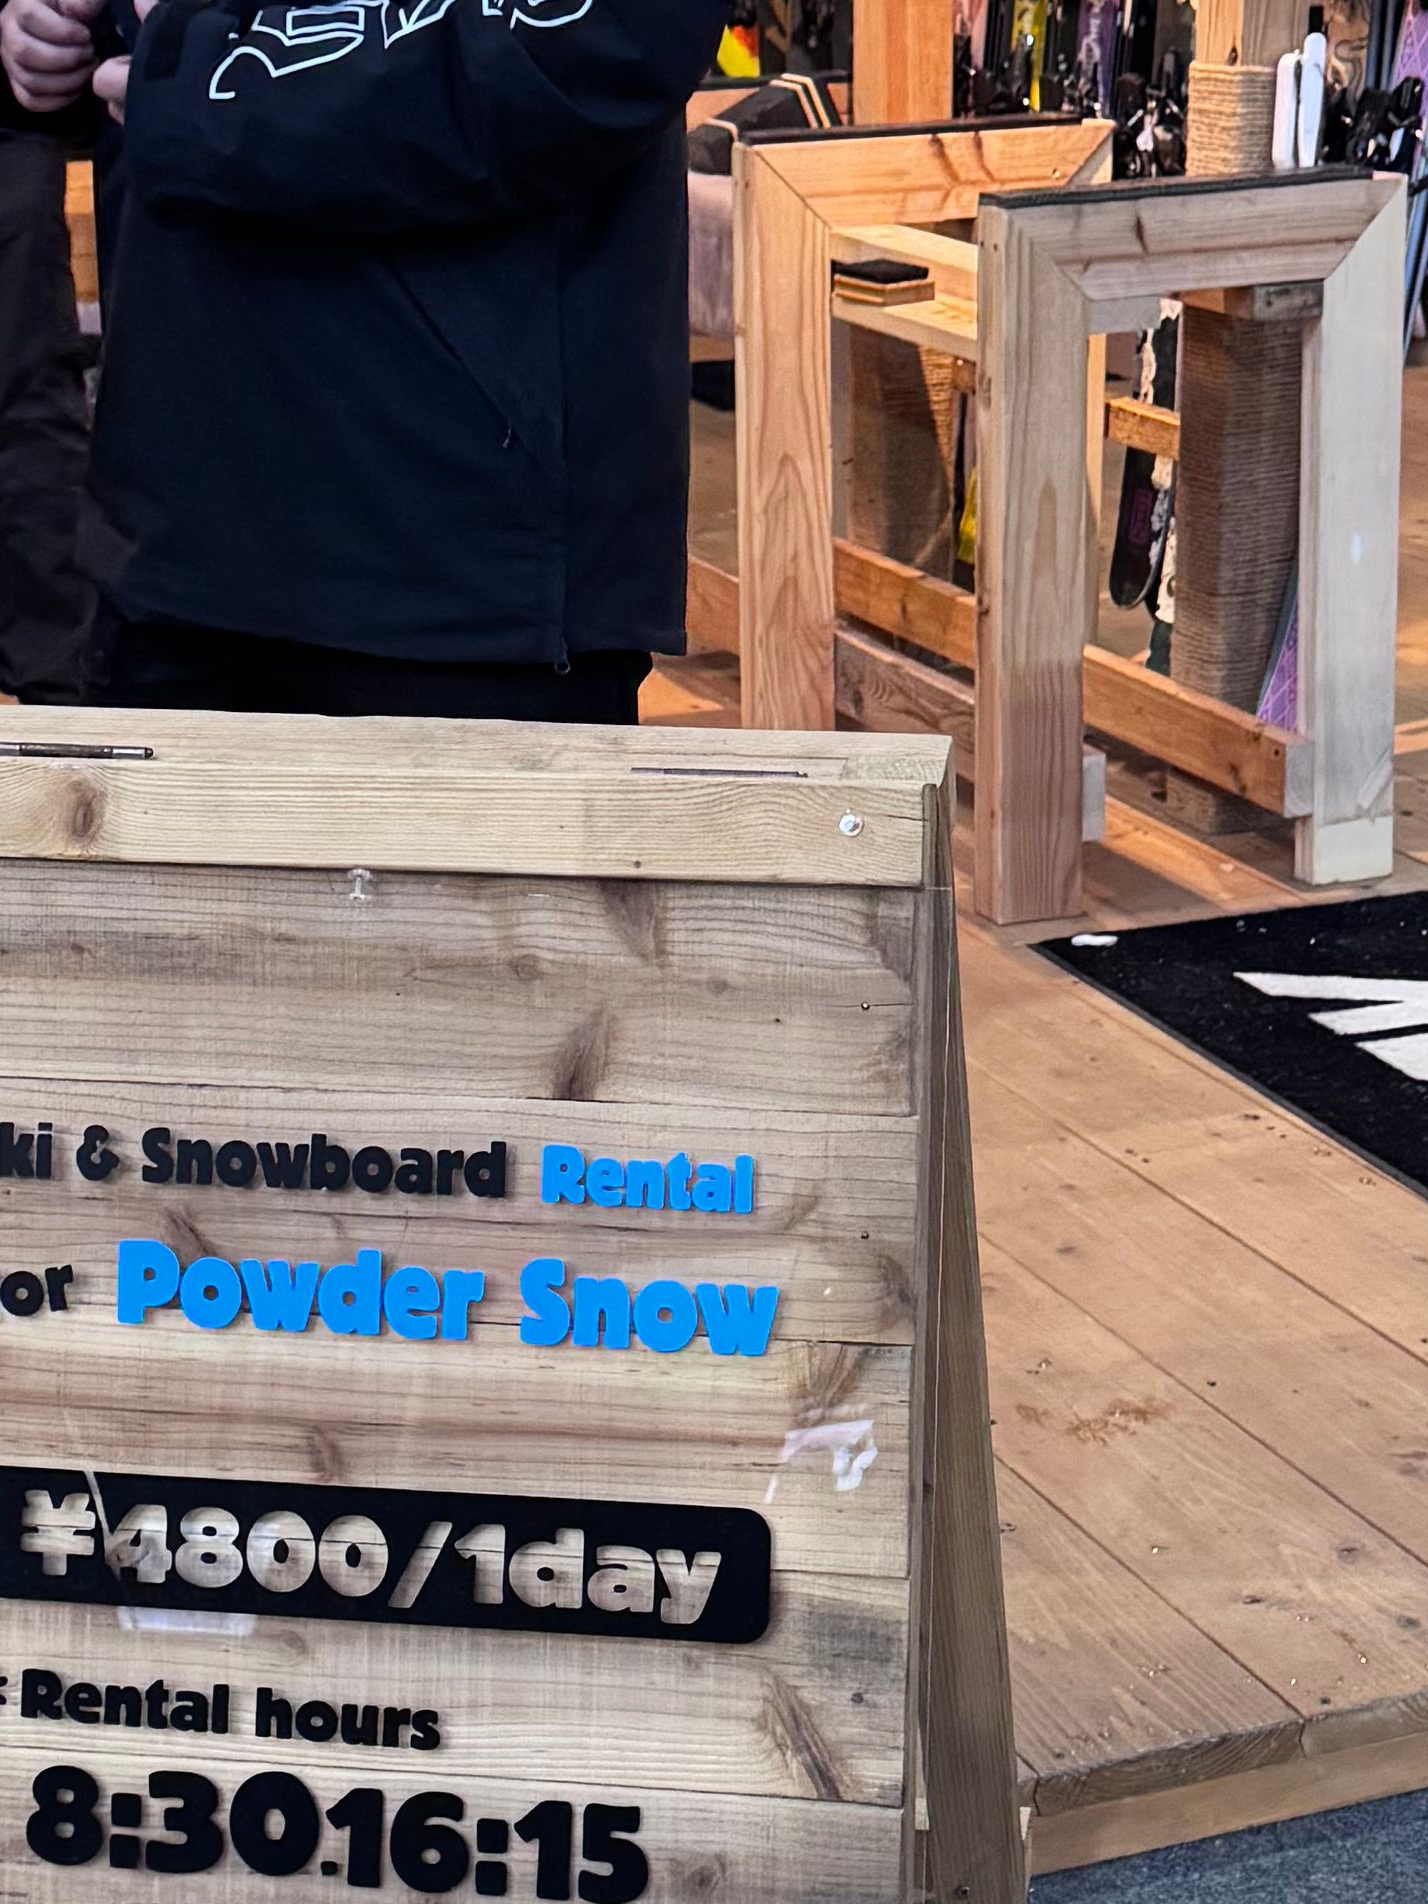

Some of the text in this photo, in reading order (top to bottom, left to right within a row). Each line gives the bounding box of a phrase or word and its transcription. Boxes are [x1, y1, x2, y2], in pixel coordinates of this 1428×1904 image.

[76, 1124, 120, 1181] &
[141, 1127, 508, 1199] Snowboard
[541, 1144, 754, 1215] Rental
[117, 1239, 486, 1342] Powder
[519, 1258, 780, 1357] Snow
[255, 1687, 441, 1751] hours
